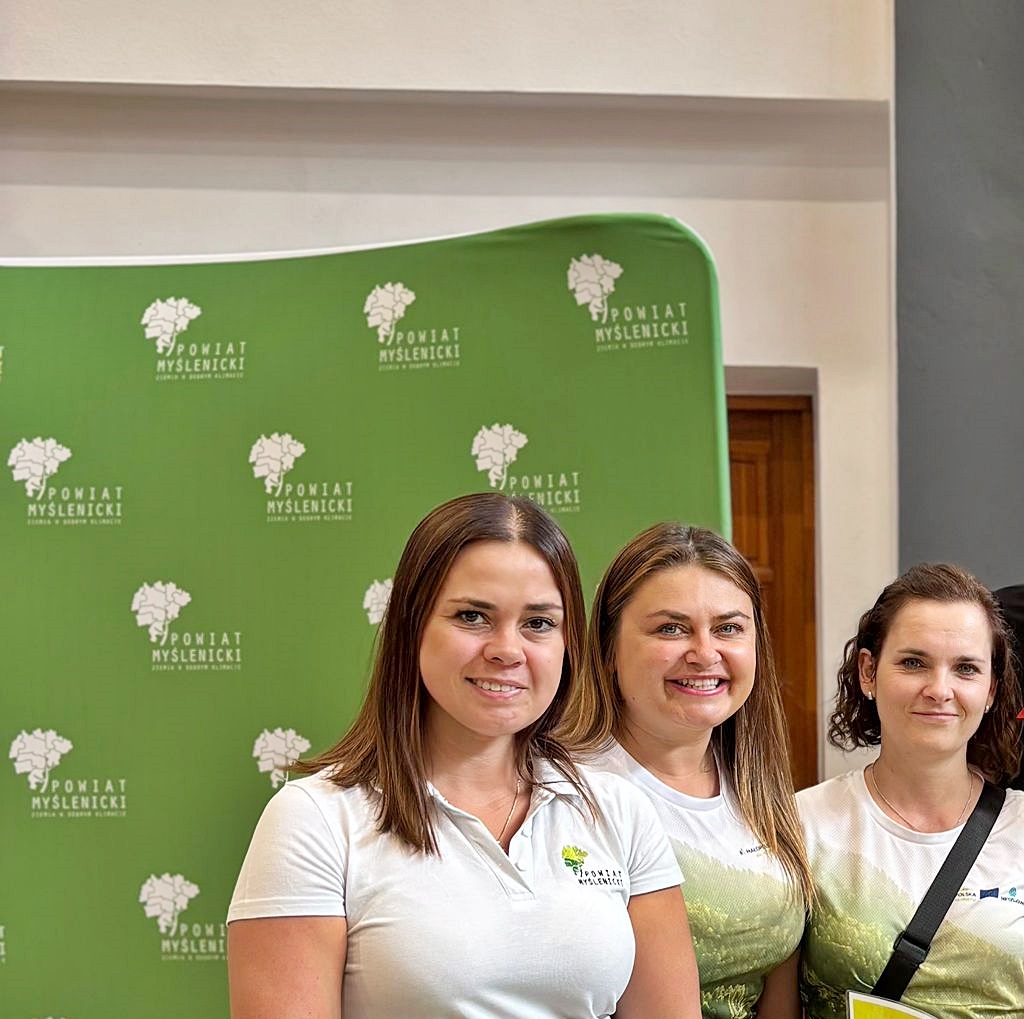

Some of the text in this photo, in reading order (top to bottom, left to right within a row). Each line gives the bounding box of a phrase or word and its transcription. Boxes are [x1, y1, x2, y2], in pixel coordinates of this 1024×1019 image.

[610, 302, 687, 323] POWIAT
[396, 326, 461, 345] POWIAT
[594, 318, 689, 343] MYŚLENICKI
[176, 341, 247, 357] POWIAT
[378, 343, 461, 363] MYŚLENICKI
[156, 355, 245, 373] MYŚLENICKI
[509, 471, 581, 490] POWIAT
[48, 486, 123, 502] POWIAT
[285, 481, 354, 498] POWIAT
[27, 501, 123, 518] MYŚLENICKI
[266, 497, 354, 515] MYŚLENICKI
[170, 631, 242, 646] POWIAT
[151, 647, 242, 663] MYŚLENICKI
[51, 779, 127, 794] POWIAT
[31, 794, 127, 810] MYŚLENICKI
[179, 922, 227, 938] POWI
[160, 937, 227, 954] MYŚLENI
